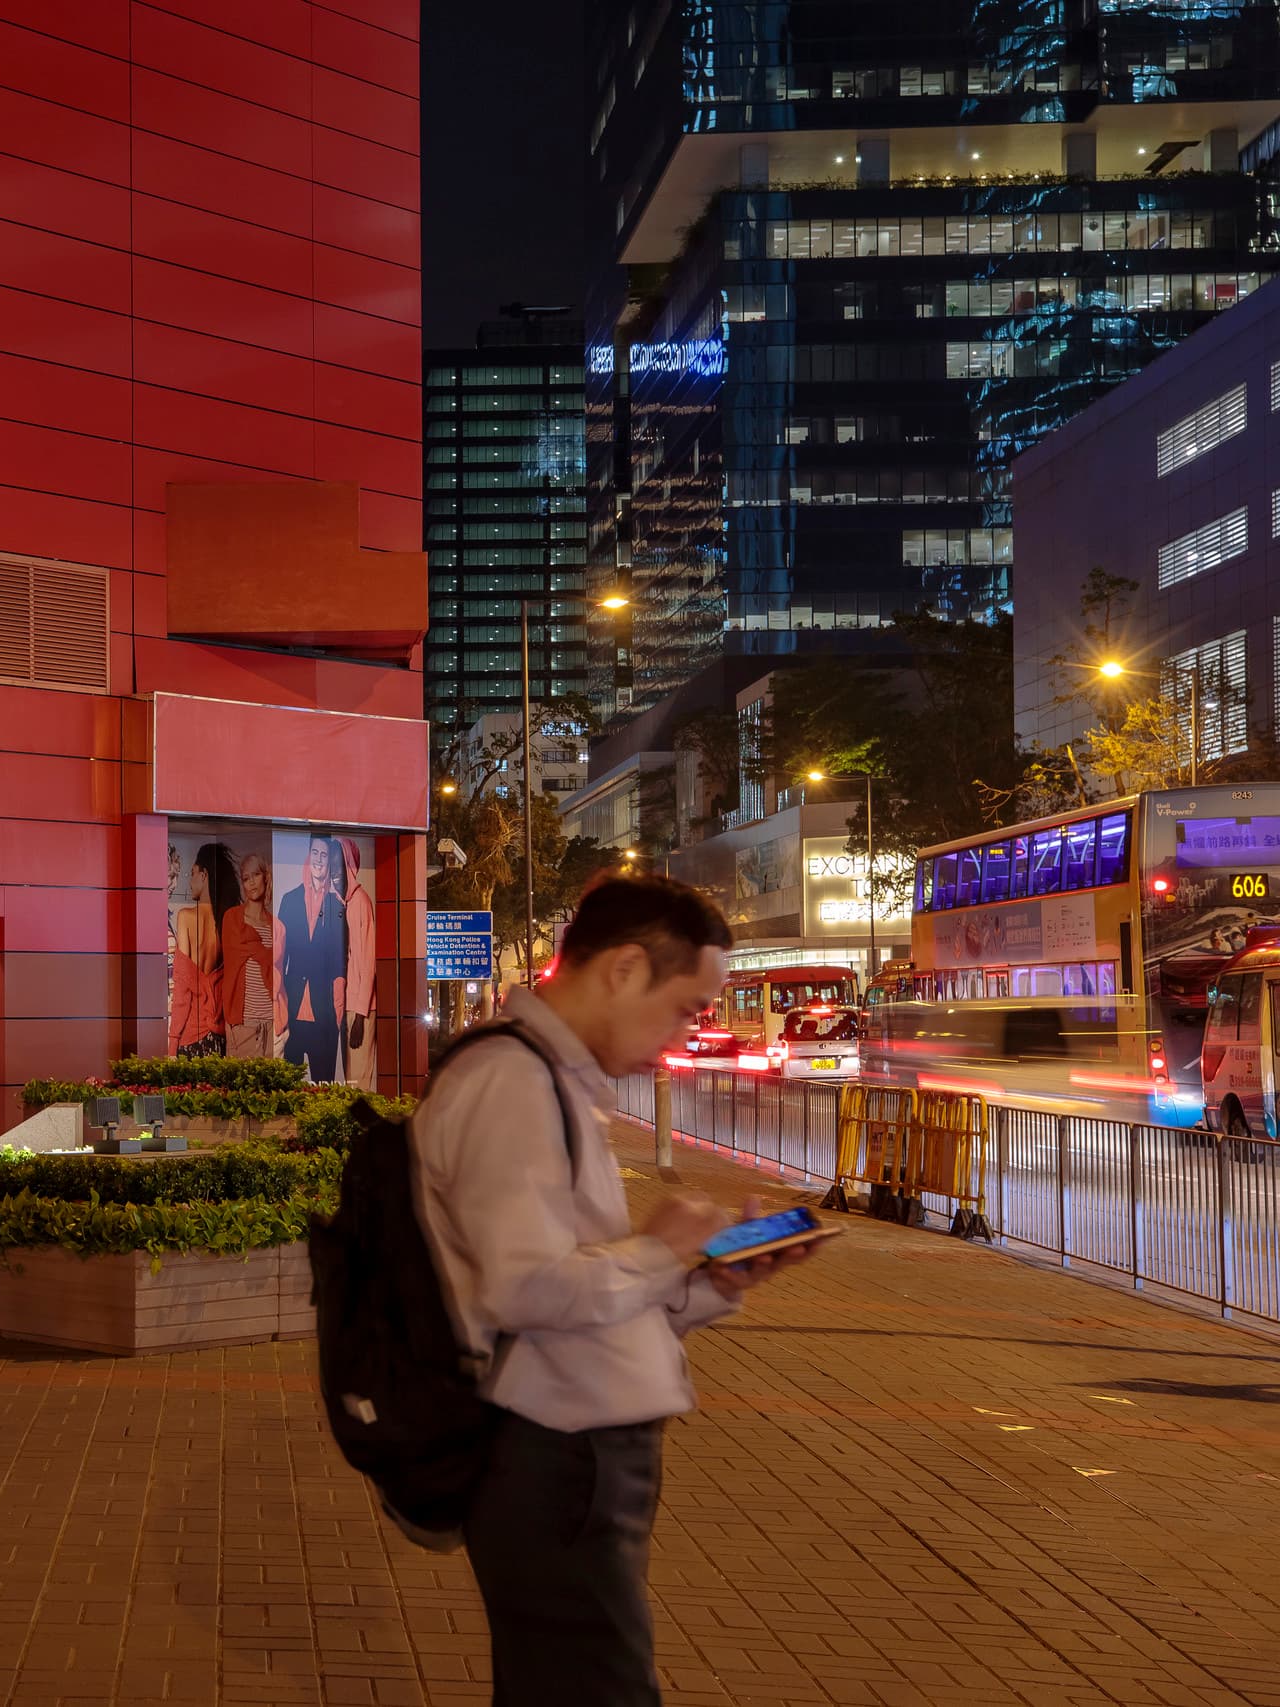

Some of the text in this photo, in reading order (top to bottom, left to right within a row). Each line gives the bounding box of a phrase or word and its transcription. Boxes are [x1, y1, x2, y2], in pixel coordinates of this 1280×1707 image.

[1232, 791, 1253, 800] 8243
[1156, 808, 1193, 816] V-Power
[1232, 875, 1266, 898] 606
